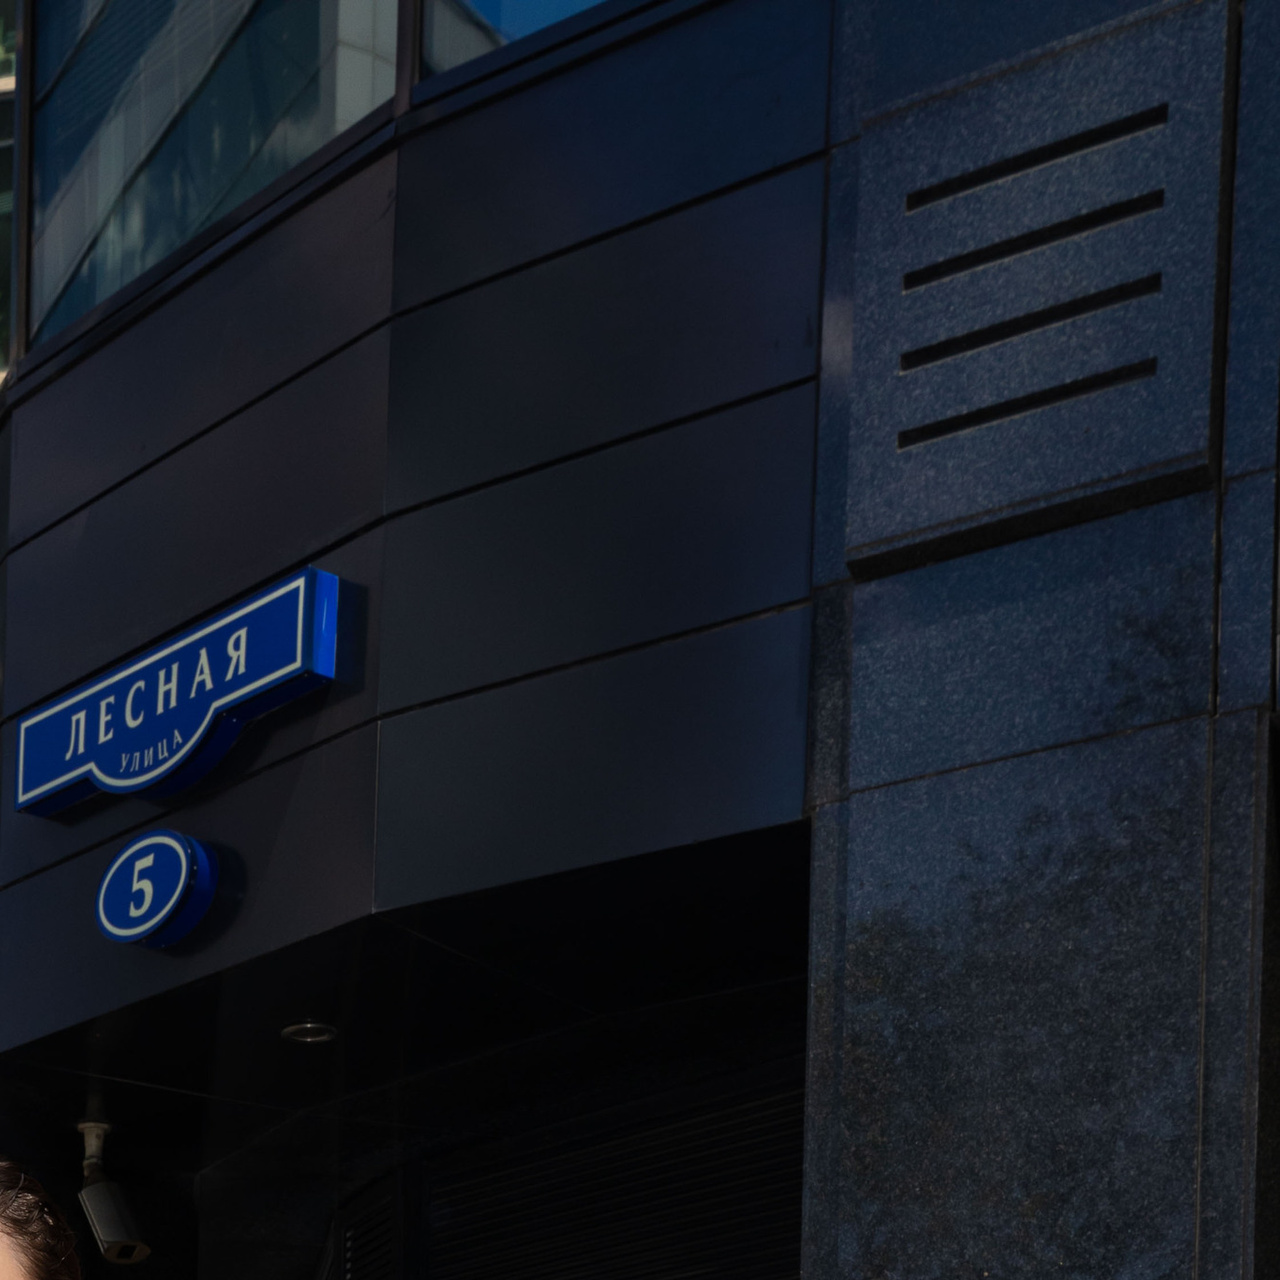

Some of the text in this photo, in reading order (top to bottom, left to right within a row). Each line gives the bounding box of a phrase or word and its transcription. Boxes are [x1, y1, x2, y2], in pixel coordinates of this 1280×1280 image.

[64, 626, 249, 762] ЛЕСНАЯ
[119, 728, 183, 773] УЛИЦА
[129, 853, 155, 918] 5
